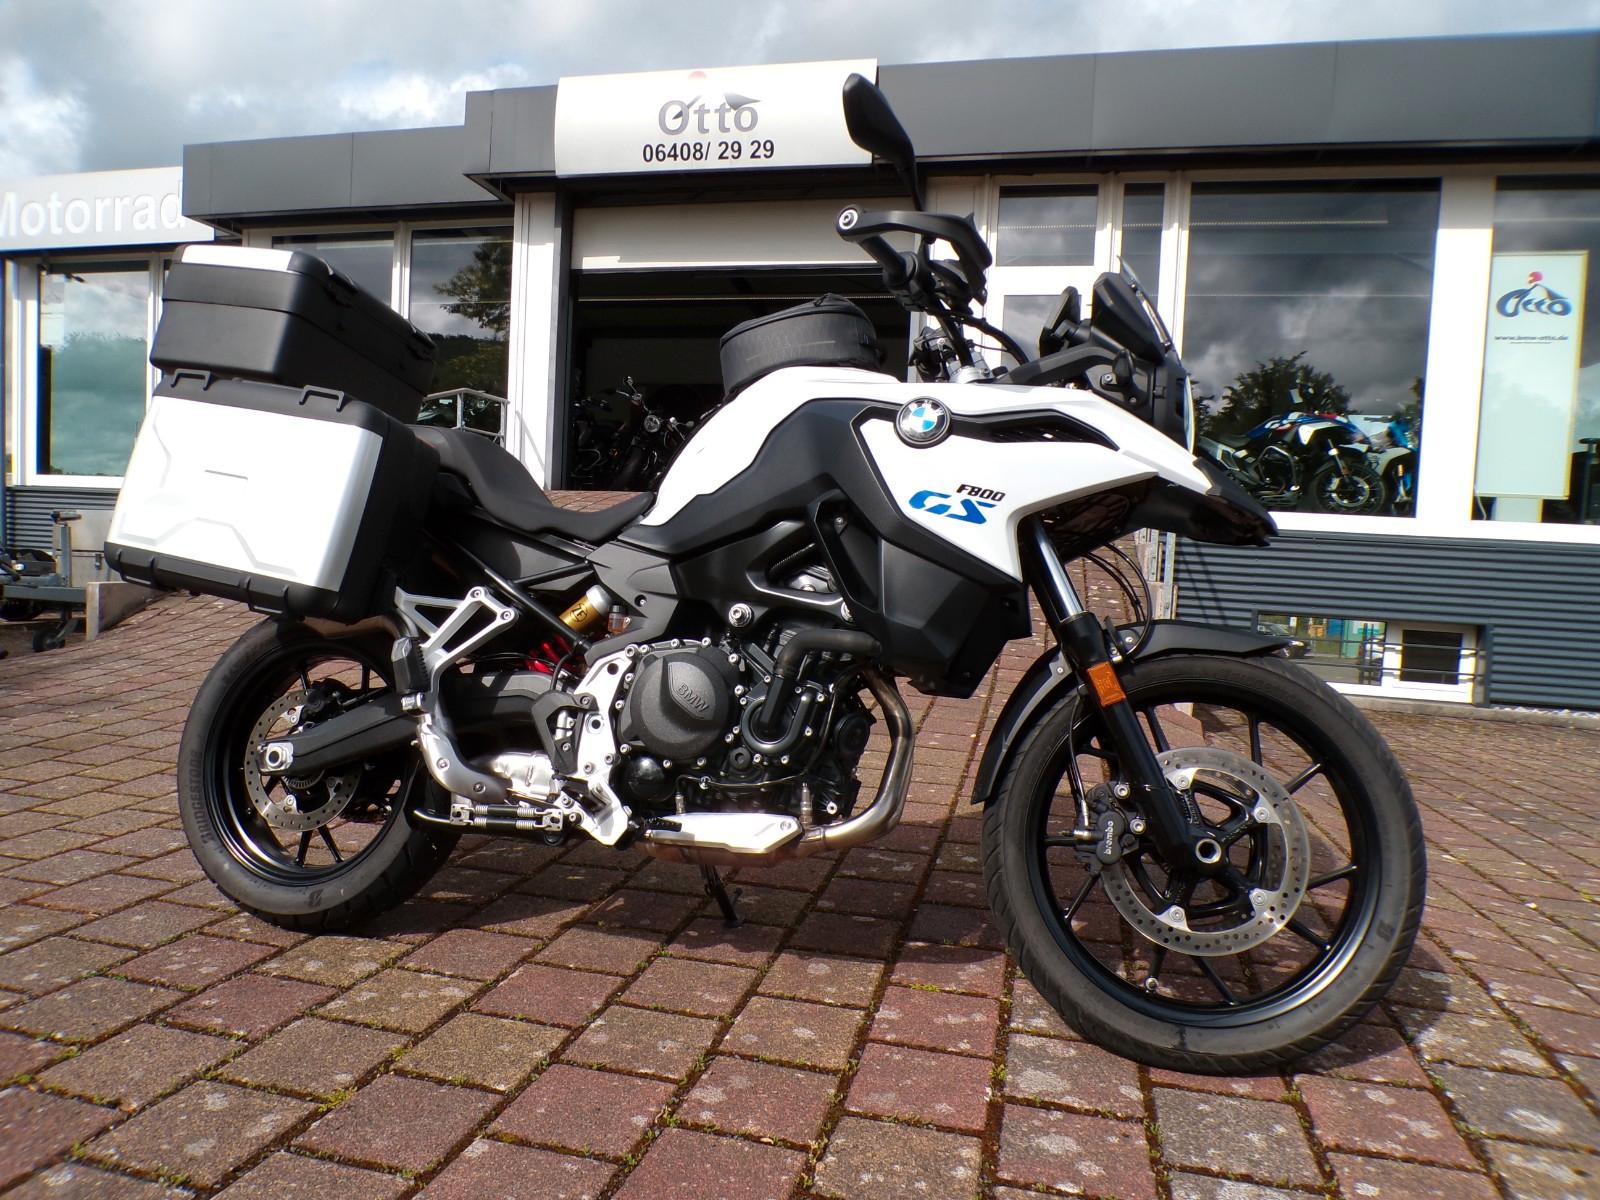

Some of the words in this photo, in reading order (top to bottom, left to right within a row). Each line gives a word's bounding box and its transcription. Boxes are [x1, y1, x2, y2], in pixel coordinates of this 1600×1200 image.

[658, 99, 759, 136] Otto
[642, 141, 711, 163] 06408/
[717, 140, 742, 160] 29
[750, 139, 775, 159] 29
[908, 490, 998, 524] GS
[956, 484, 1006, 502] F800
[678, 681, 710, 713] BMW
[1103, 820, 1114, 855] brembo
